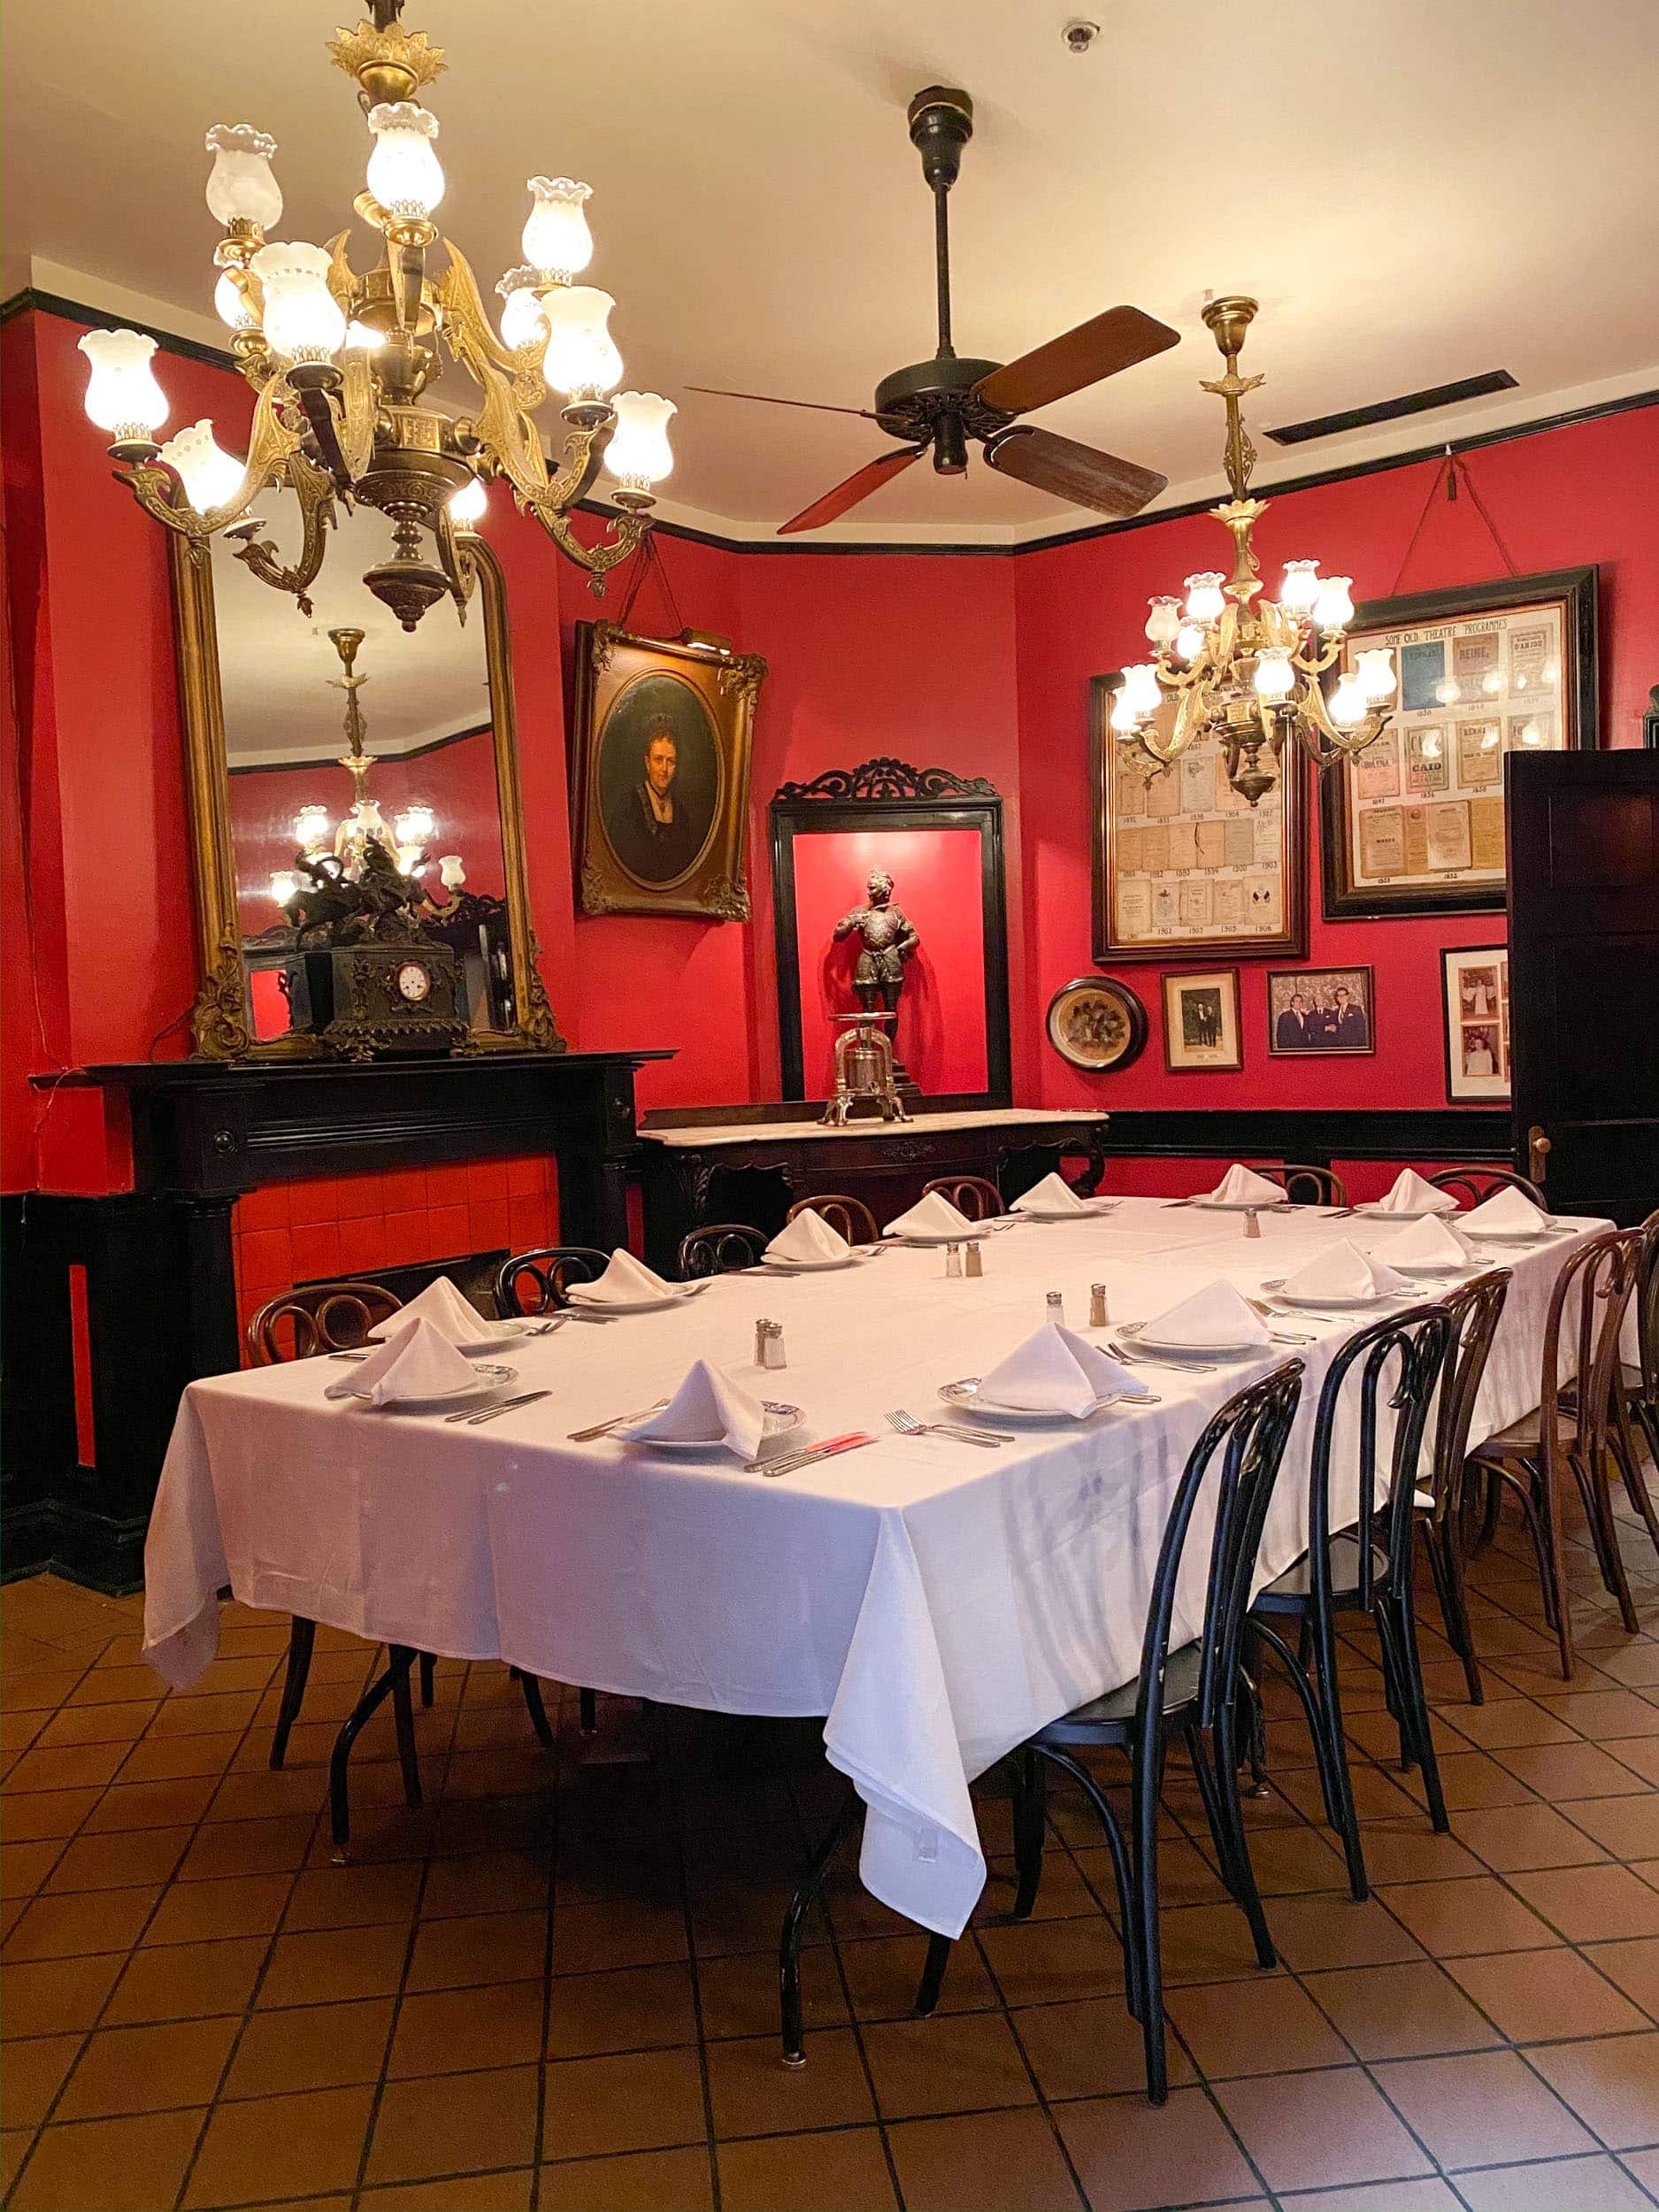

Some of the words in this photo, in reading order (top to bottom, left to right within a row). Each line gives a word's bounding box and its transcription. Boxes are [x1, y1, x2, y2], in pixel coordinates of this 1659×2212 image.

[1403, 631, 1418, 643] OLD
[1424, 625, 1457, 640] THEATRE
[1464, 618, 1508, 634] PROGRAMMES
[1412, 763, 1441, 772] CAID
